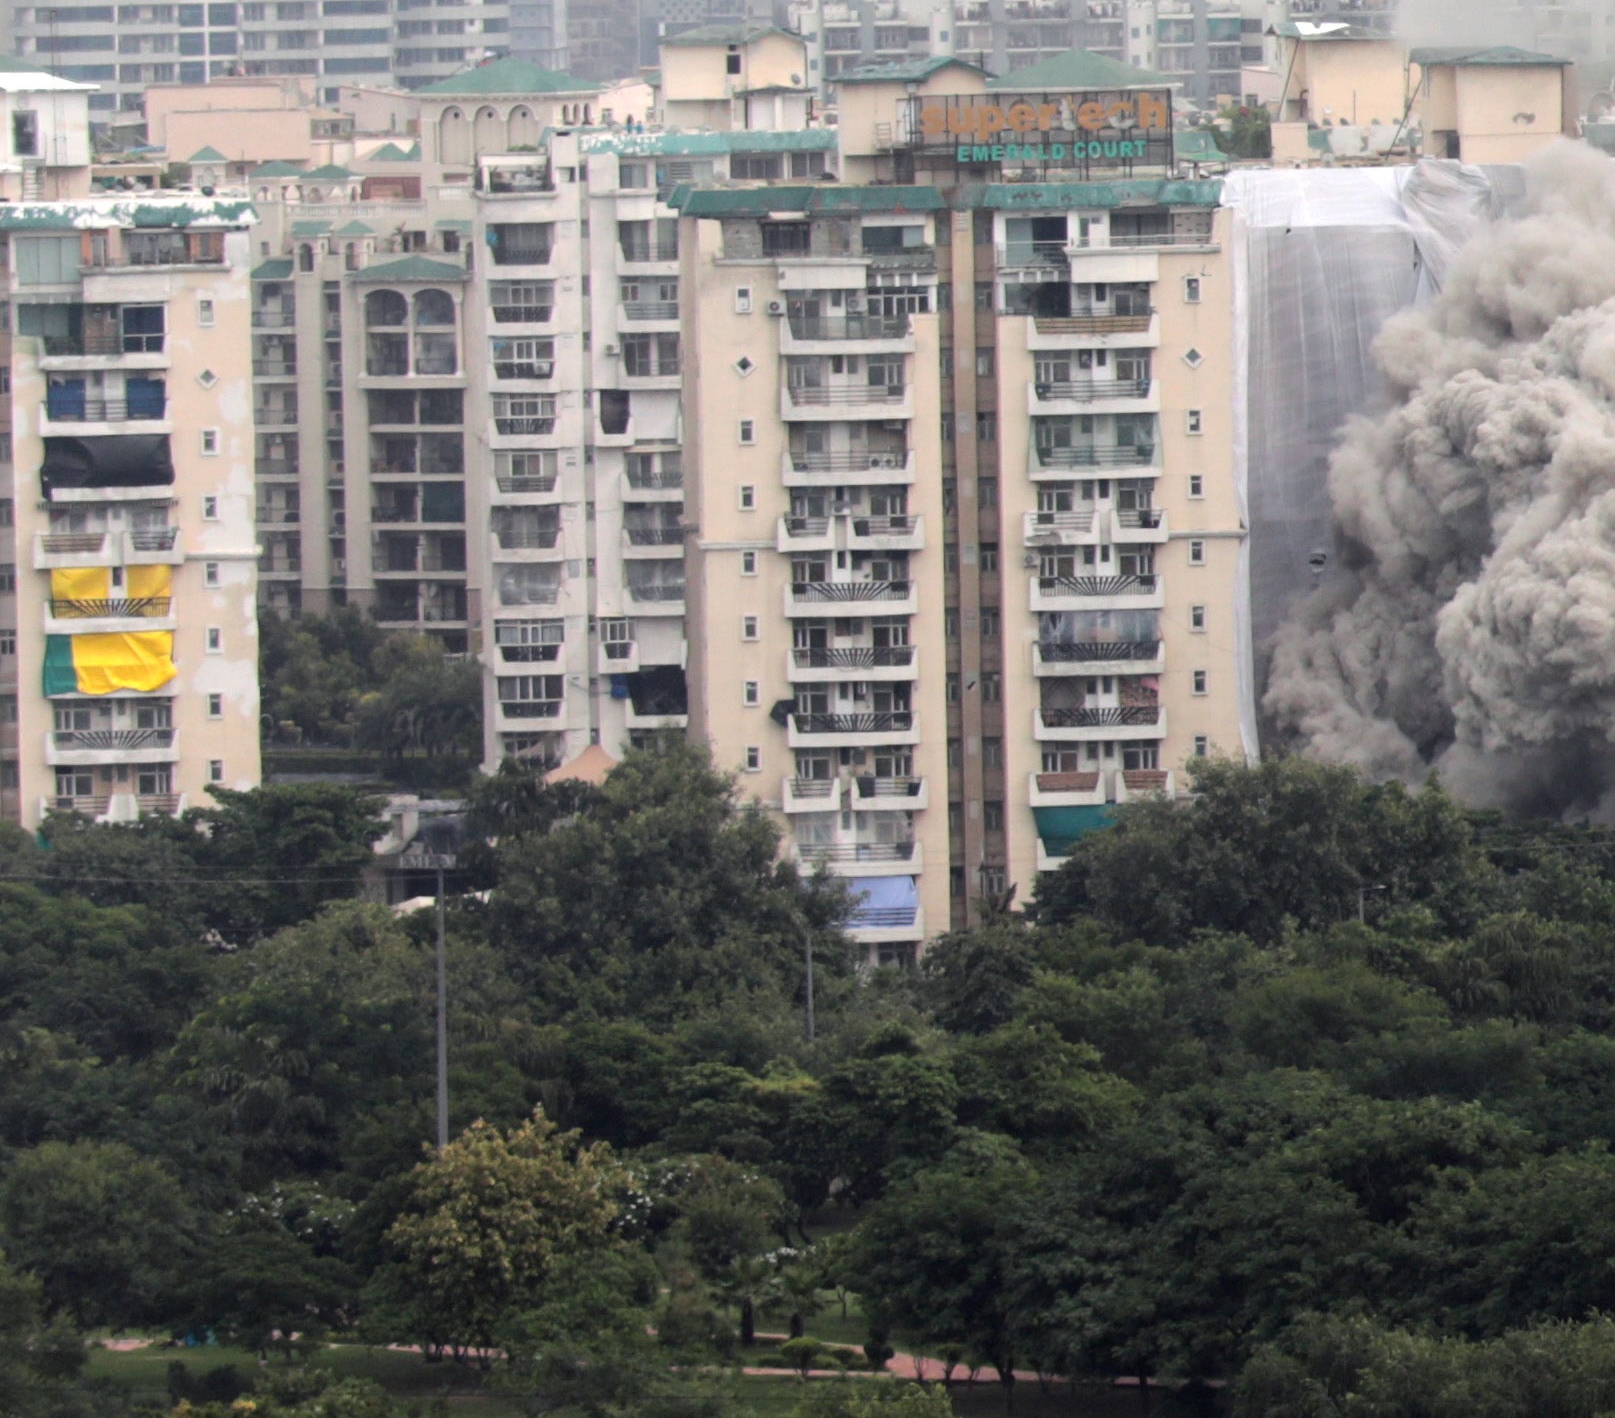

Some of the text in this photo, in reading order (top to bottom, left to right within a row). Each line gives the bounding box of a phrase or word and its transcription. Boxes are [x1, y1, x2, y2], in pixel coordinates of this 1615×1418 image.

[920, 91, 1168, 141] supertech
[956, 139, 1147, 162] EMERALD COURT
